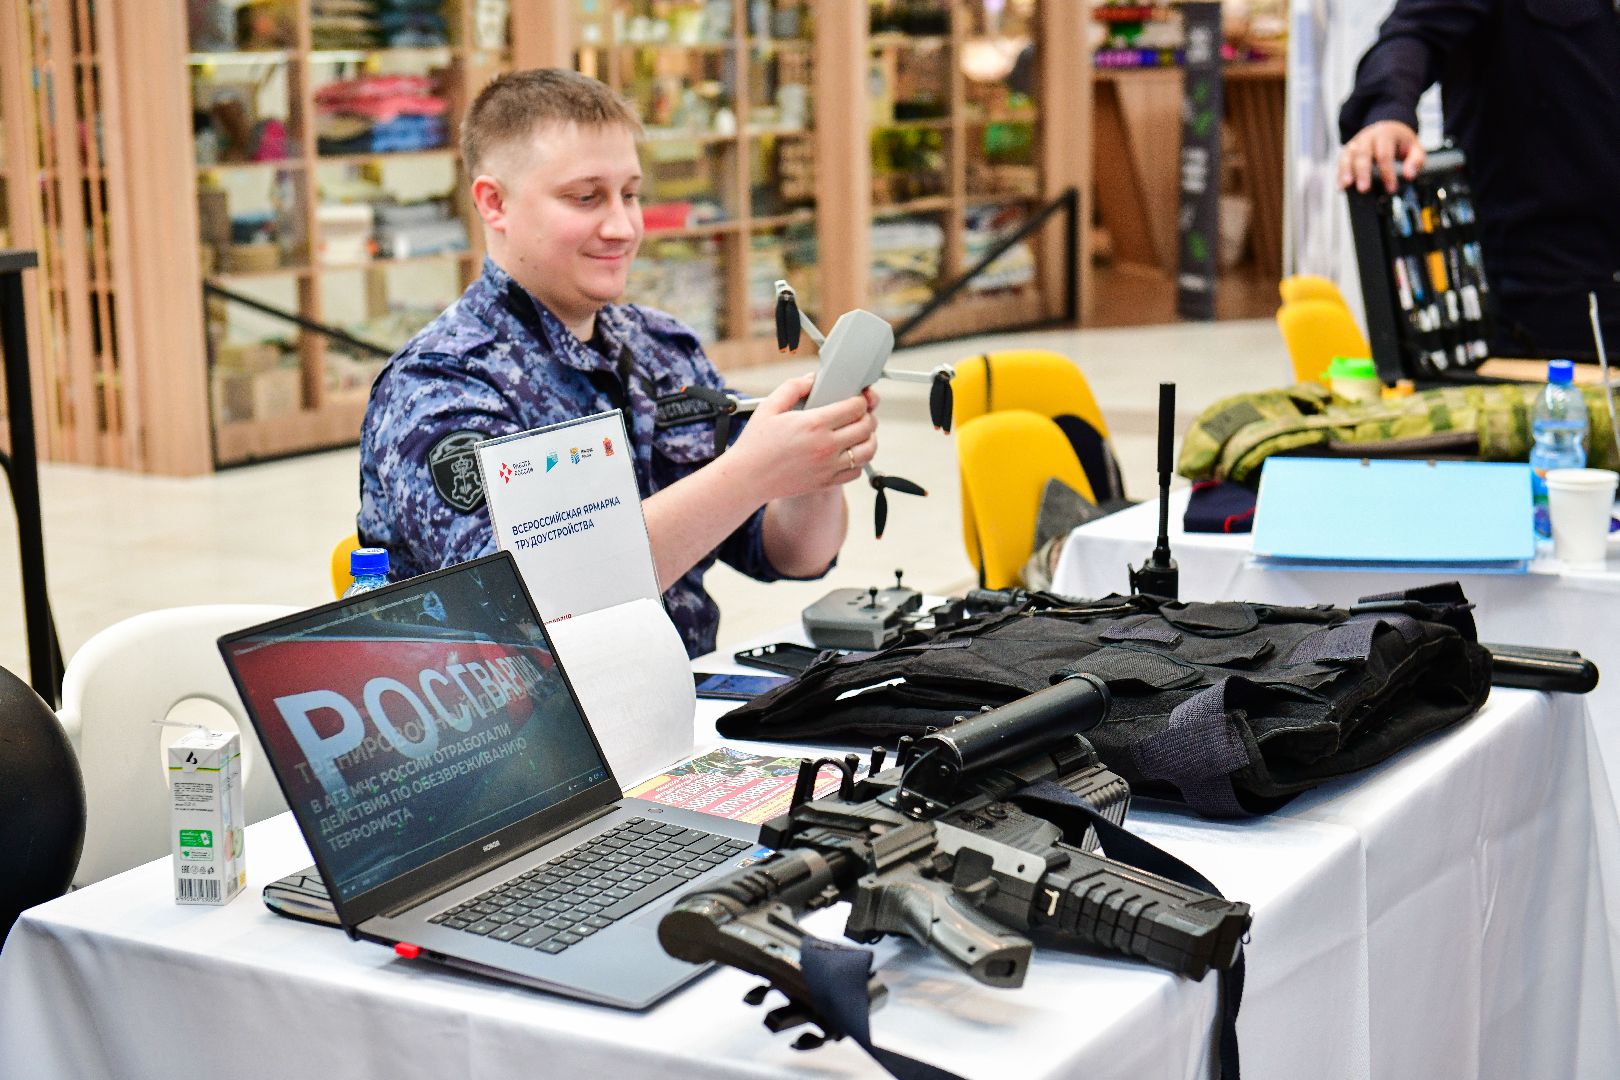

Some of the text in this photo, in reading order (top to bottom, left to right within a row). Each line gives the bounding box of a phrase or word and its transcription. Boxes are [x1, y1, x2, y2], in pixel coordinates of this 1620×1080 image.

[512, 496, 621, 536] ВСЕРОССИЙСКАЯ ЯРМАРКА
[515, 519, 595, 550] ТРУДОУСТРОЙСТВА
[310, 798, 323, 815] В
[350, 776, 380, 798] МЧС
[380, 755, 434, 786] РОССИИ
[433, 722, 512, 764] ОТРАБОТАЛИ
[320, 737, 527, 835] ДЕЙСТВИЯ ПО ОБЕЗВРЕЖИВАНИЮ
[327, 806, 414, 852] ТЕРРОРИСТА
